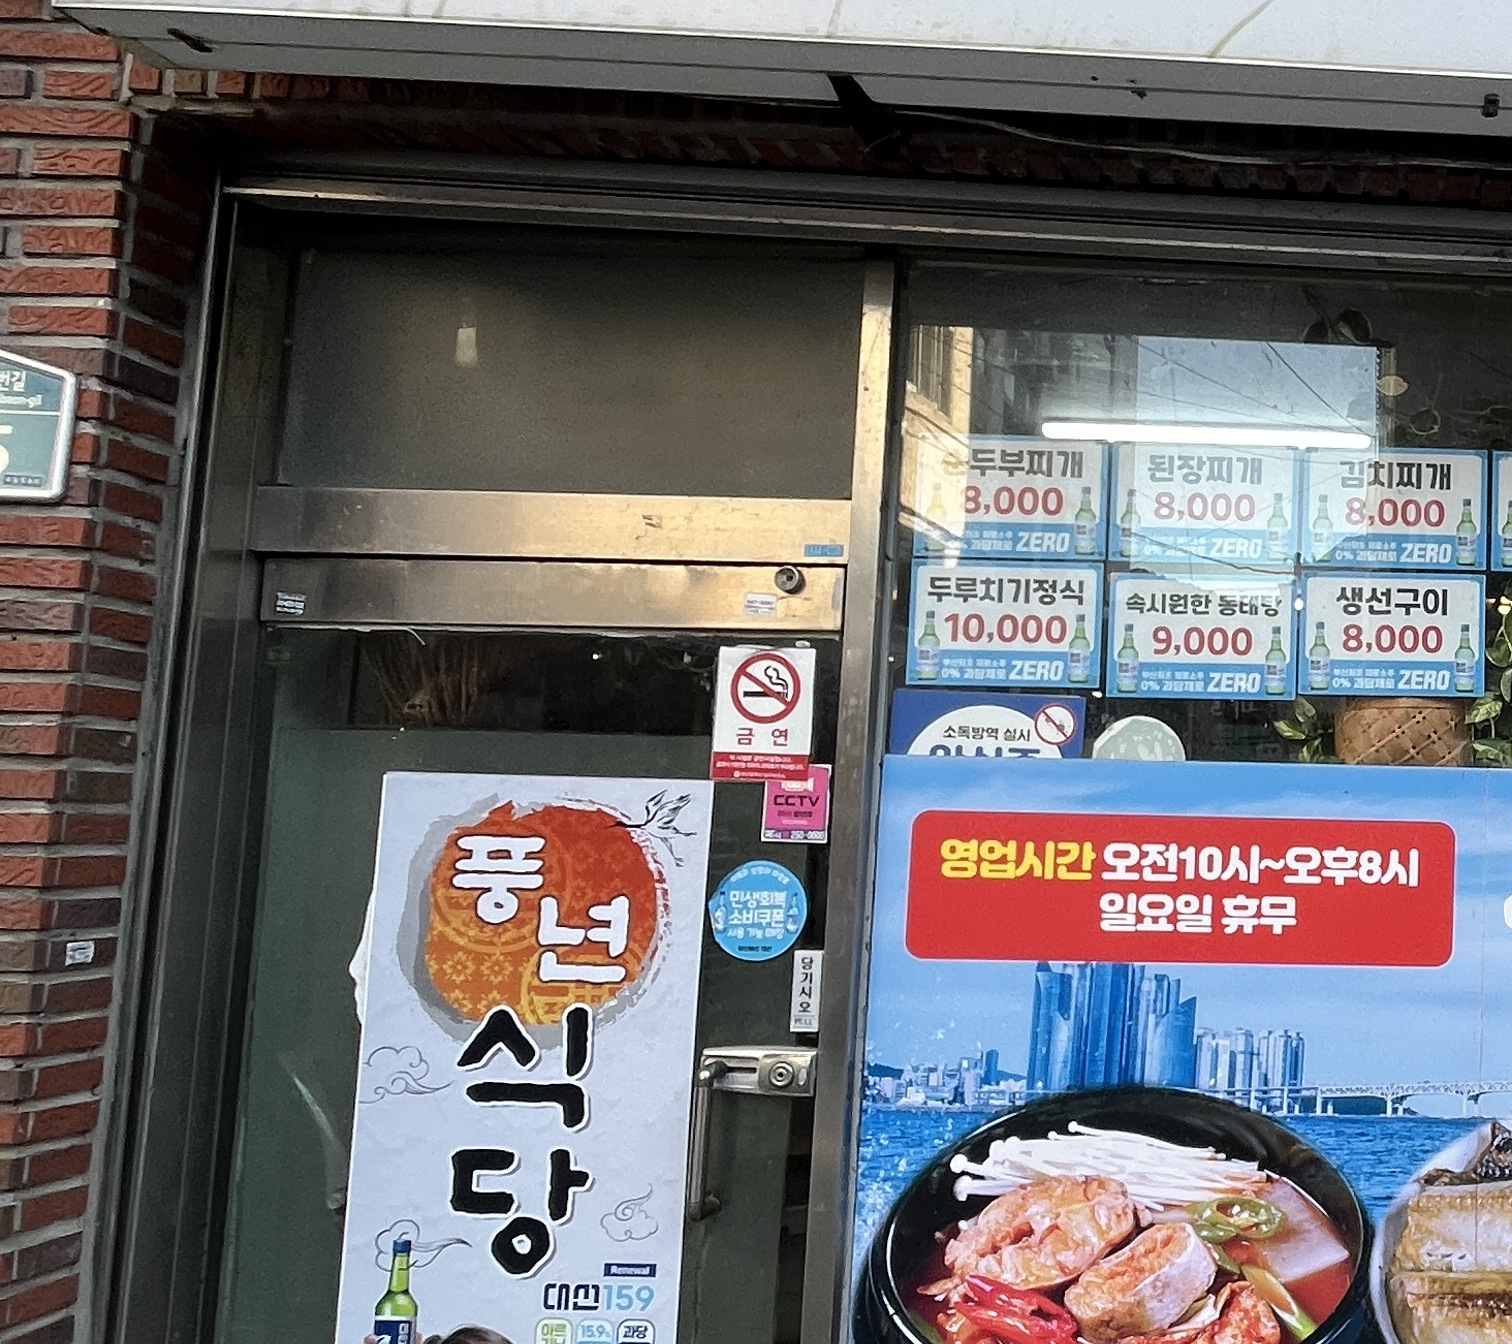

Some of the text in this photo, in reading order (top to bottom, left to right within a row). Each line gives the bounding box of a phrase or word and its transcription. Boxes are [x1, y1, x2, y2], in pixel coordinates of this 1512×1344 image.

[1148, 454, 1263, 485] 된장찌개
[1339, 460, 1452, 490] 김치찌개
[961, 485, 1064, 516] 8,000
[1154, 492, 1255, 521] 8,000
[1345, 497, 1446, 528] 8,000
[1015, 531, 1070, 553] ZERO
[1210, 537, 1263, 558] ZERO
[1401, 543, 1453, 564] ZERO
[927, 576, 1085, 606] 두루치기정식
[1336, 587, 1448, 617] 생선구이
[1126, 593, 1283, 617] 속시원한 동태탕
[943, 612, 1067, 645] 10,000
[1342, 624, 1443, 654] 8,000
[1152, 626, 1253, 656] 9,000
[941, 668, 960, 678] 0%
[1009, 660, 1064, 681] ZERO
[1207, 672, 1261, 693] ZERO
[1398, 669, 1450, 691] ZERO
[1141, 681, 1160, 691] 0%
[1332, 678, 1351, 688] 0%
[943, 725, 1031, 742] 소독방역 실시
[774, 794, 819, 807] CCTV
[940, 838, 1420, 888] 영업시간 오전10시~오후8시
[729, 890, 787, 908] 민생회복
[728, 909, 785, 927] 소비쿠폰
[1099, 893, 1298, 935] 일요일 휴무
[798, 956, 814, 1013] 당기시오
[544, 1282, 655, 1312] 대선 159
[623, 1325, 648, 1339] 과당
